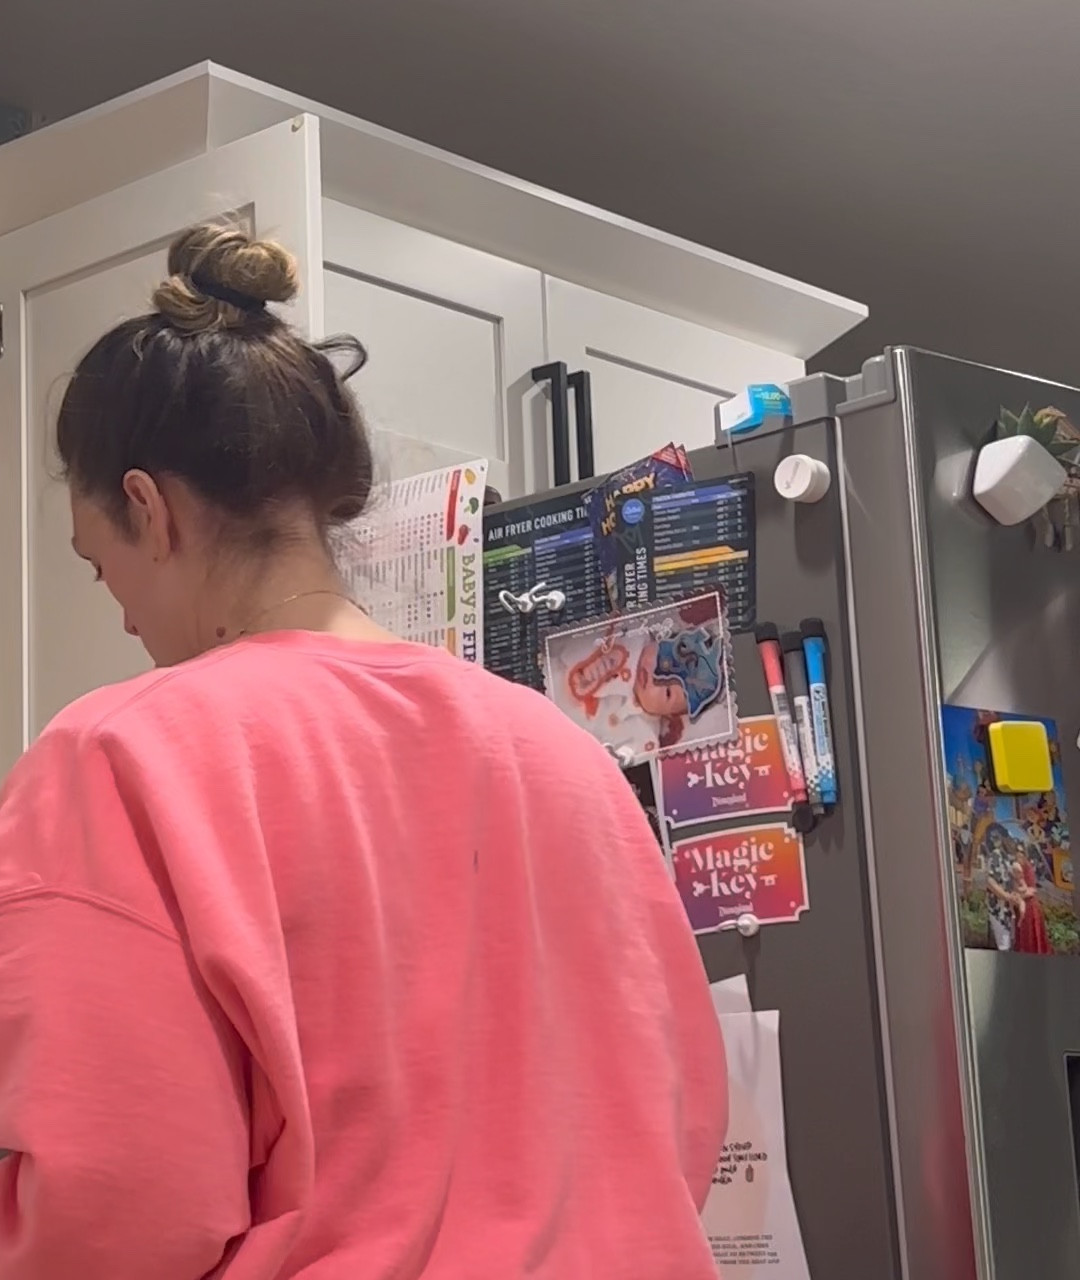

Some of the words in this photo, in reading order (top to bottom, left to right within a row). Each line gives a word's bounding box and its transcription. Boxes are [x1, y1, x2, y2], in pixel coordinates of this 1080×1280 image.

[487, 527, 504, 542] AIR
[505, 520, 533, 538] FRYER
[533, 508, 575, 530] COOKING
[624, 562, 636, 597] FRYER
[635, 546, 648, 580] TIMES
[636, 583, 648, 607] ING
[684, 835, 775, 873] Magic
